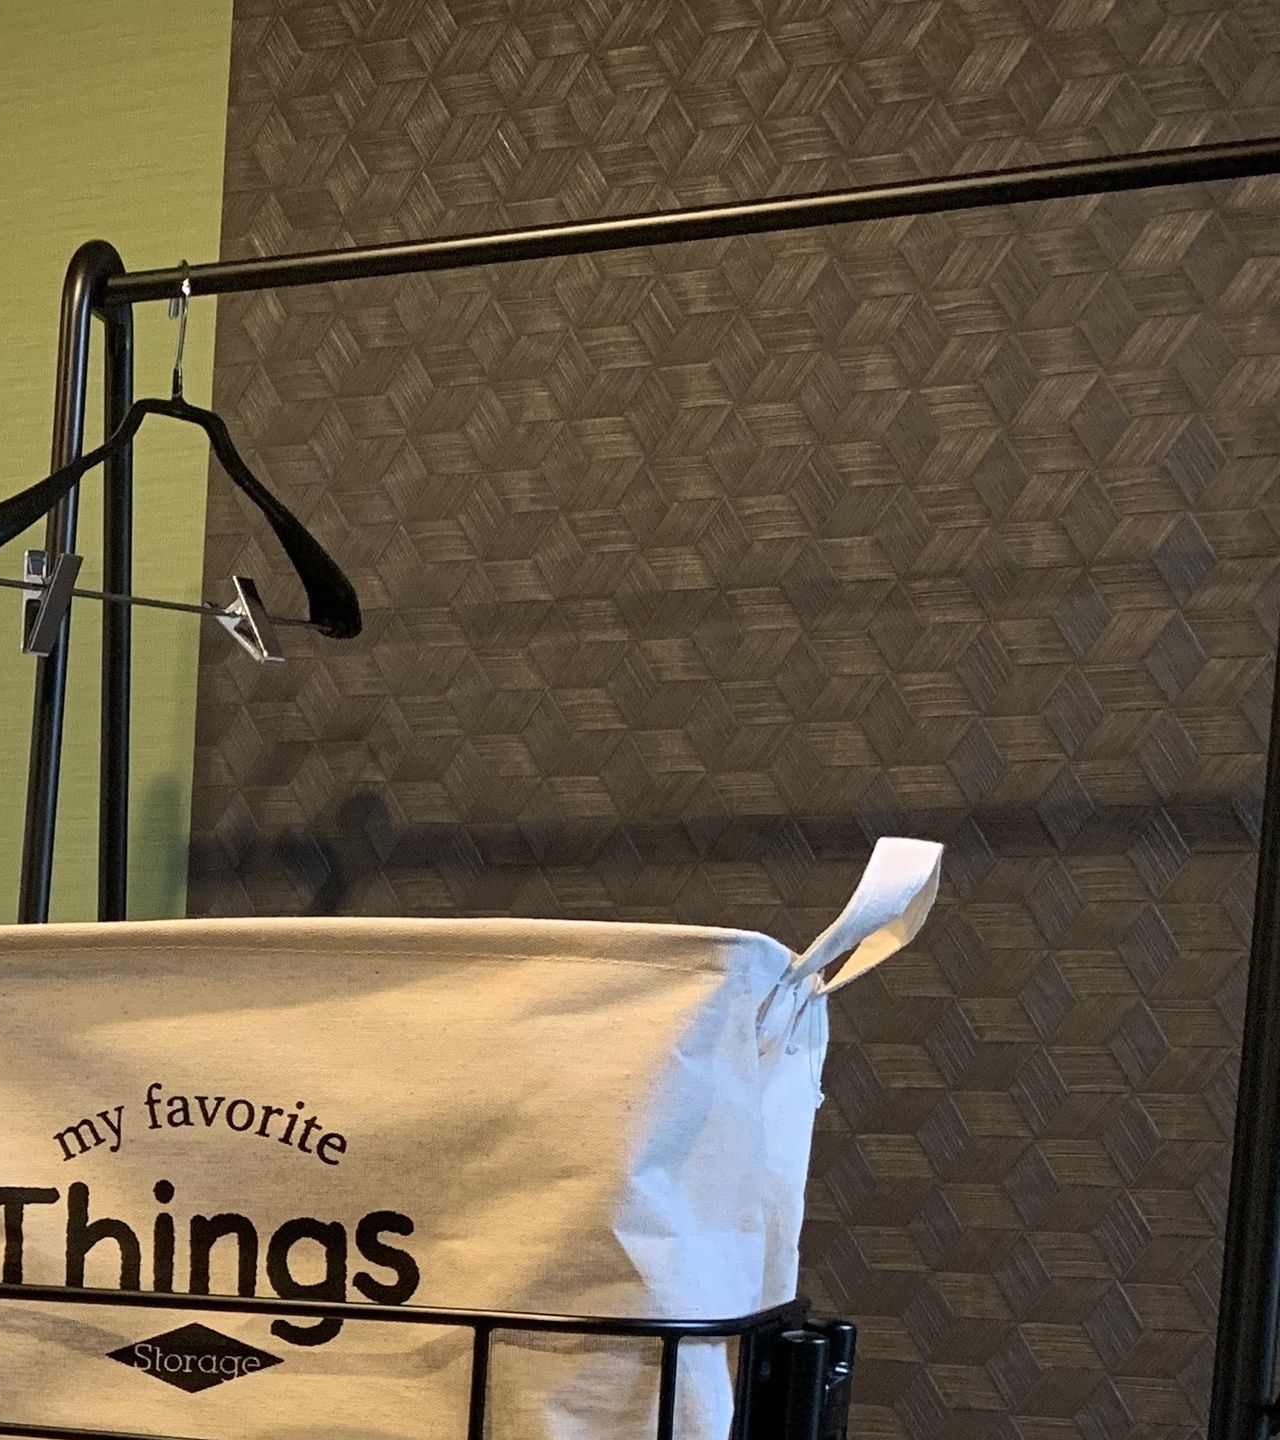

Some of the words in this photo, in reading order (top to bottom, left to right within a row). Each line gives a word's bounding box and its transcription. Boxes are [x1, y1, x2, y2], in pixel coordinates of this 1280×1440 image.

[52, 1104, 126, 1163] my
[143, 1081, 348, 1166] favorite
[132, 1343, 262, 1381] Storage
